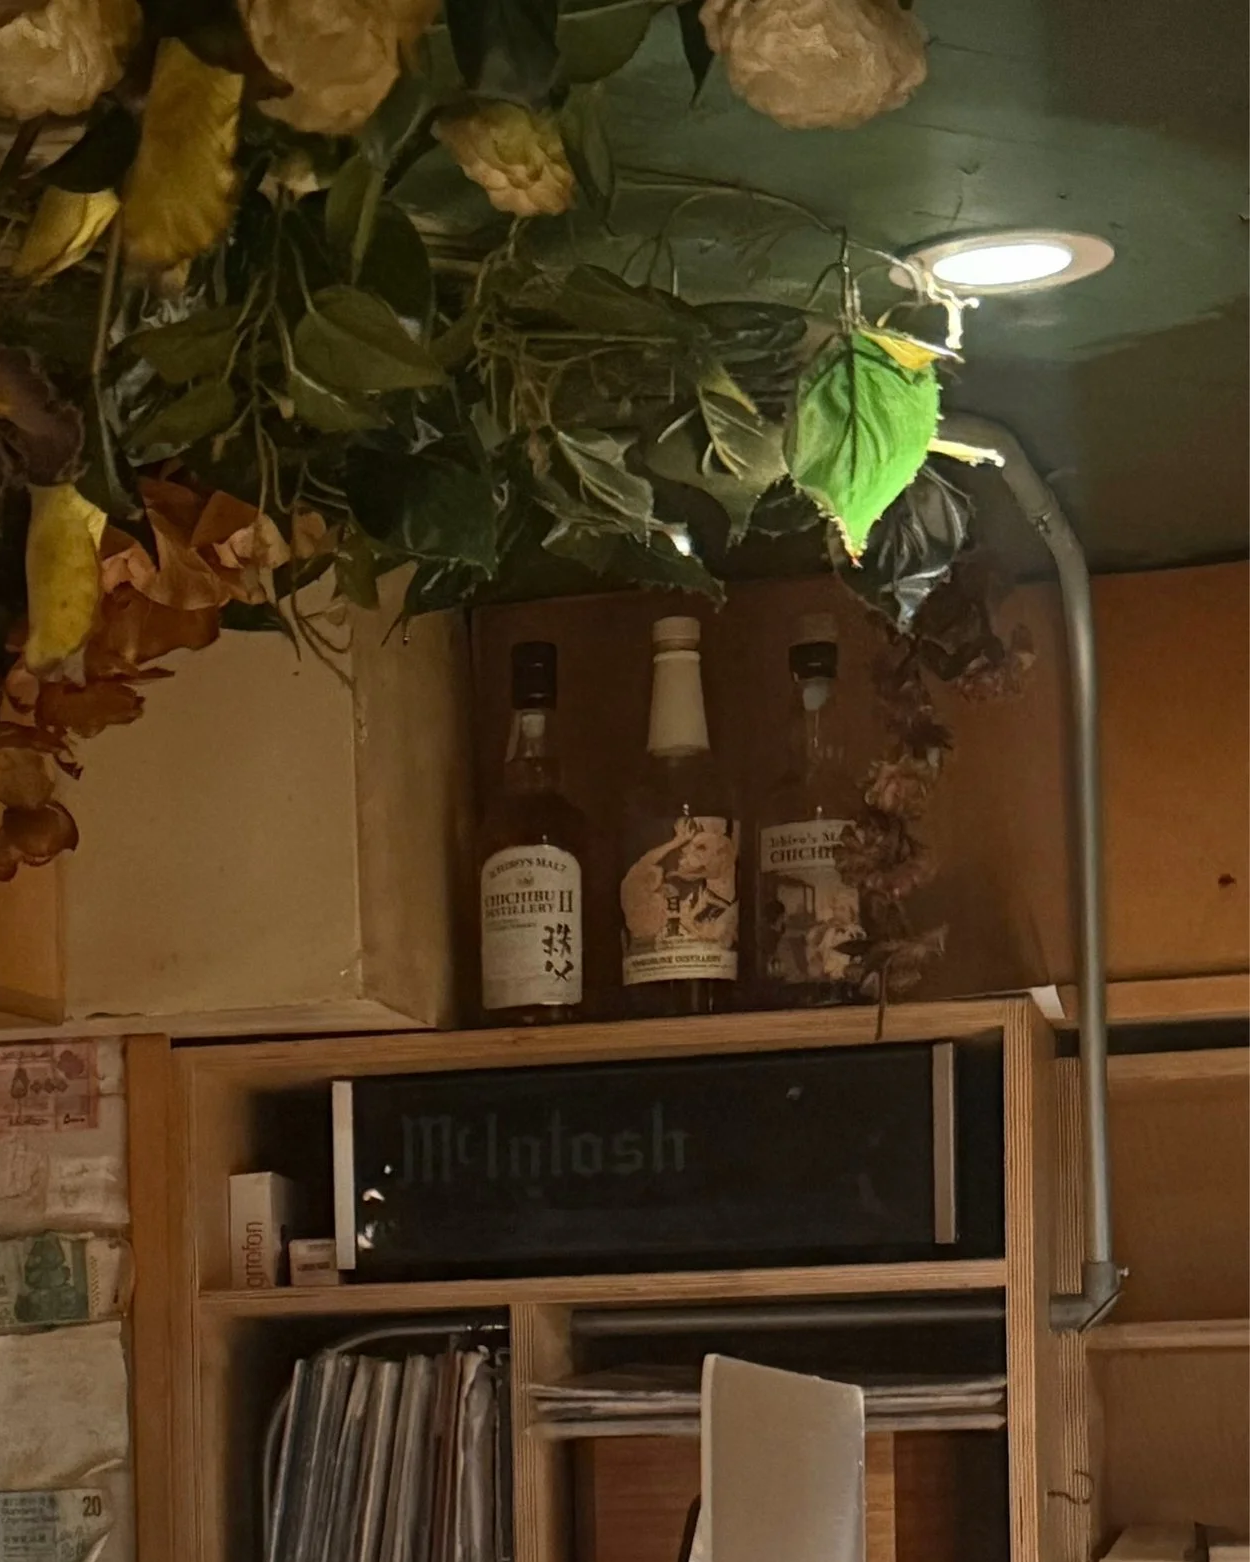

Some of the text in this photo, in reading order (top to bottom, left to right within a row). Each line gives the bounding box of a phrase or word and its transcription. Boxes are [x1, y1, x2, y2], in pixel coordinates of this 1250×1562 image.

[485, 890, 554, 909] CHICHIBU
[485, 903, 554, 919] DISTILLERY
[401, 1102, 693, 1182] McIntosh
[83, 1496, 102, 1517] 20
